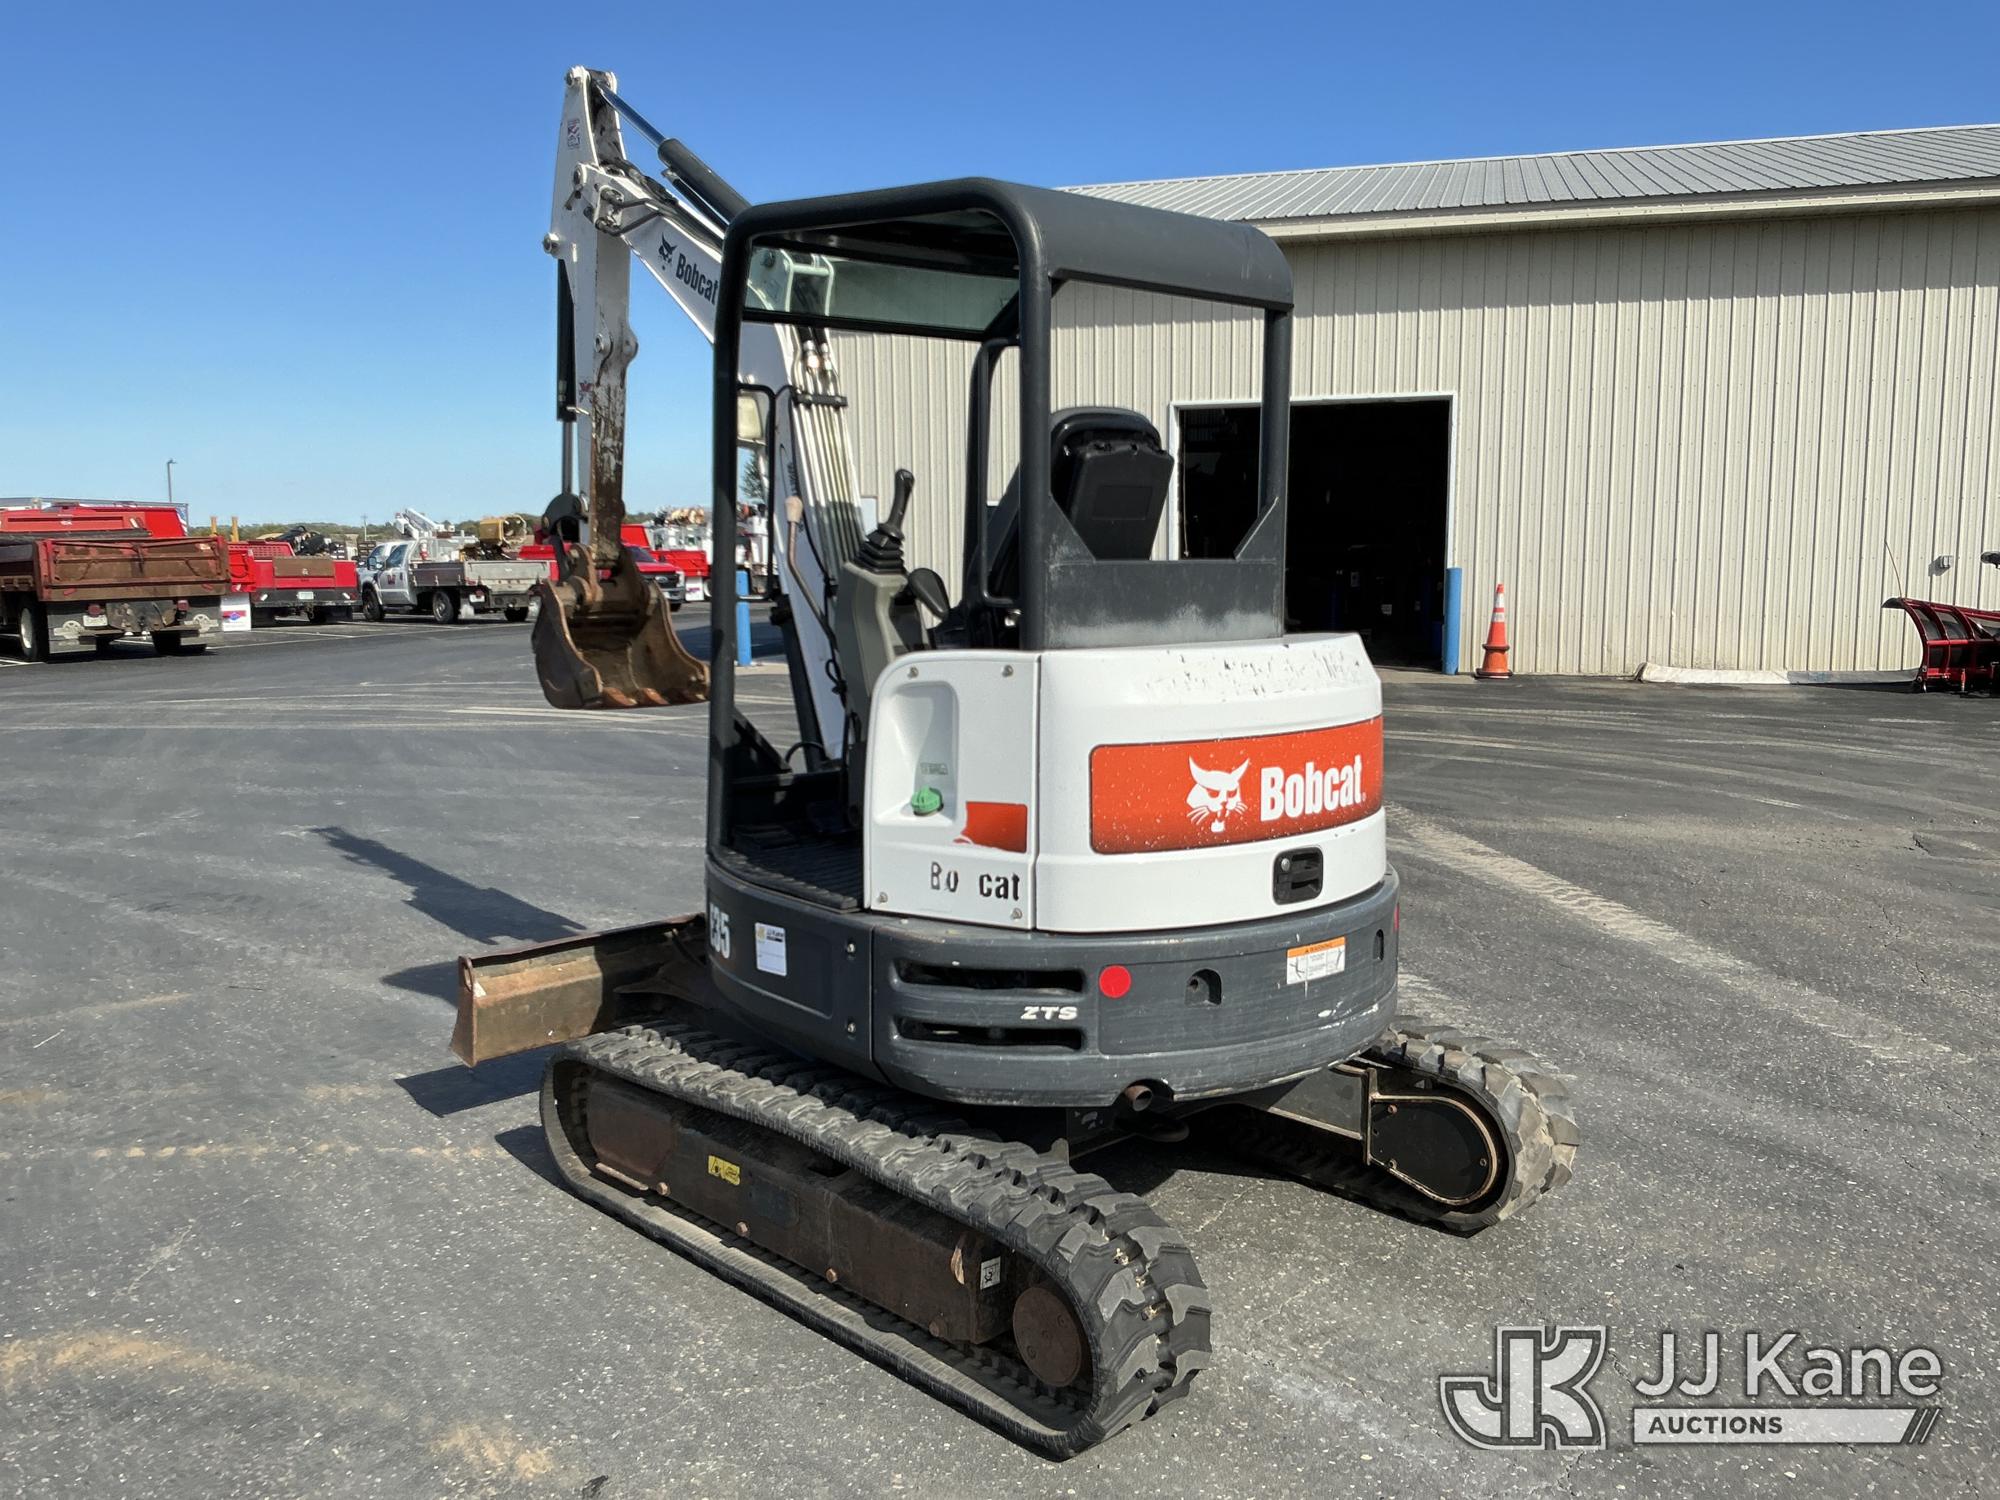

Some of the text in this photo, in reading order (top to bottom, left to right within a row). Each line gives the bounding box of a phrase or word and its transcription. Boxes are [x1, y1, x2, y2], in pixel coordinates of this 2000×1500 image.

[675, 252, 718, 305] Bobcat
[1260, 754, 1363, 822] Bobcat
[1020, 1005, 1078, 1020] ZTS
